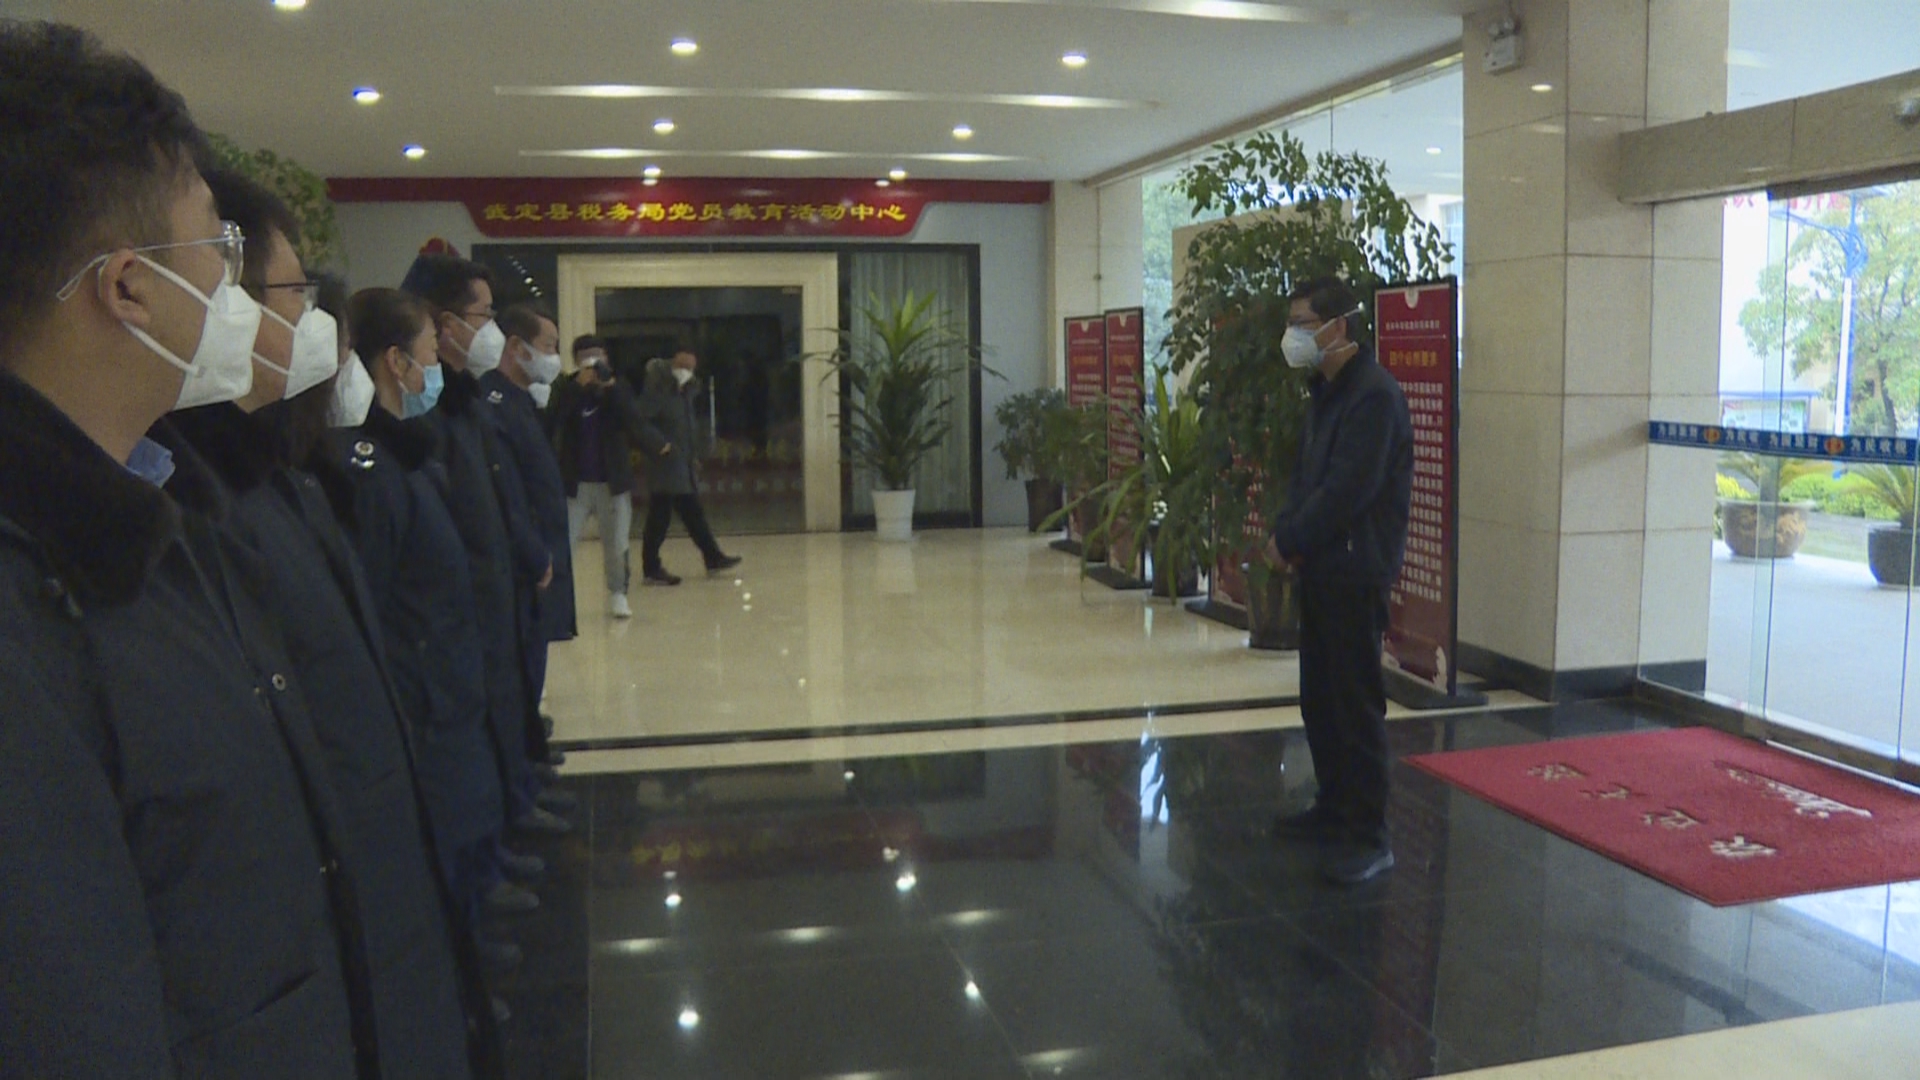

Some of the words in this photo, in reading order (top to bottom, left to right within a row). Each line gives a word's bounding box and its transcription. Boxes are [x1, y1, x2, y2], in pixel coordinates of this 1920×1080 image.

[484, 203, 906, 221] 武定县税务局党员教育活动中心
